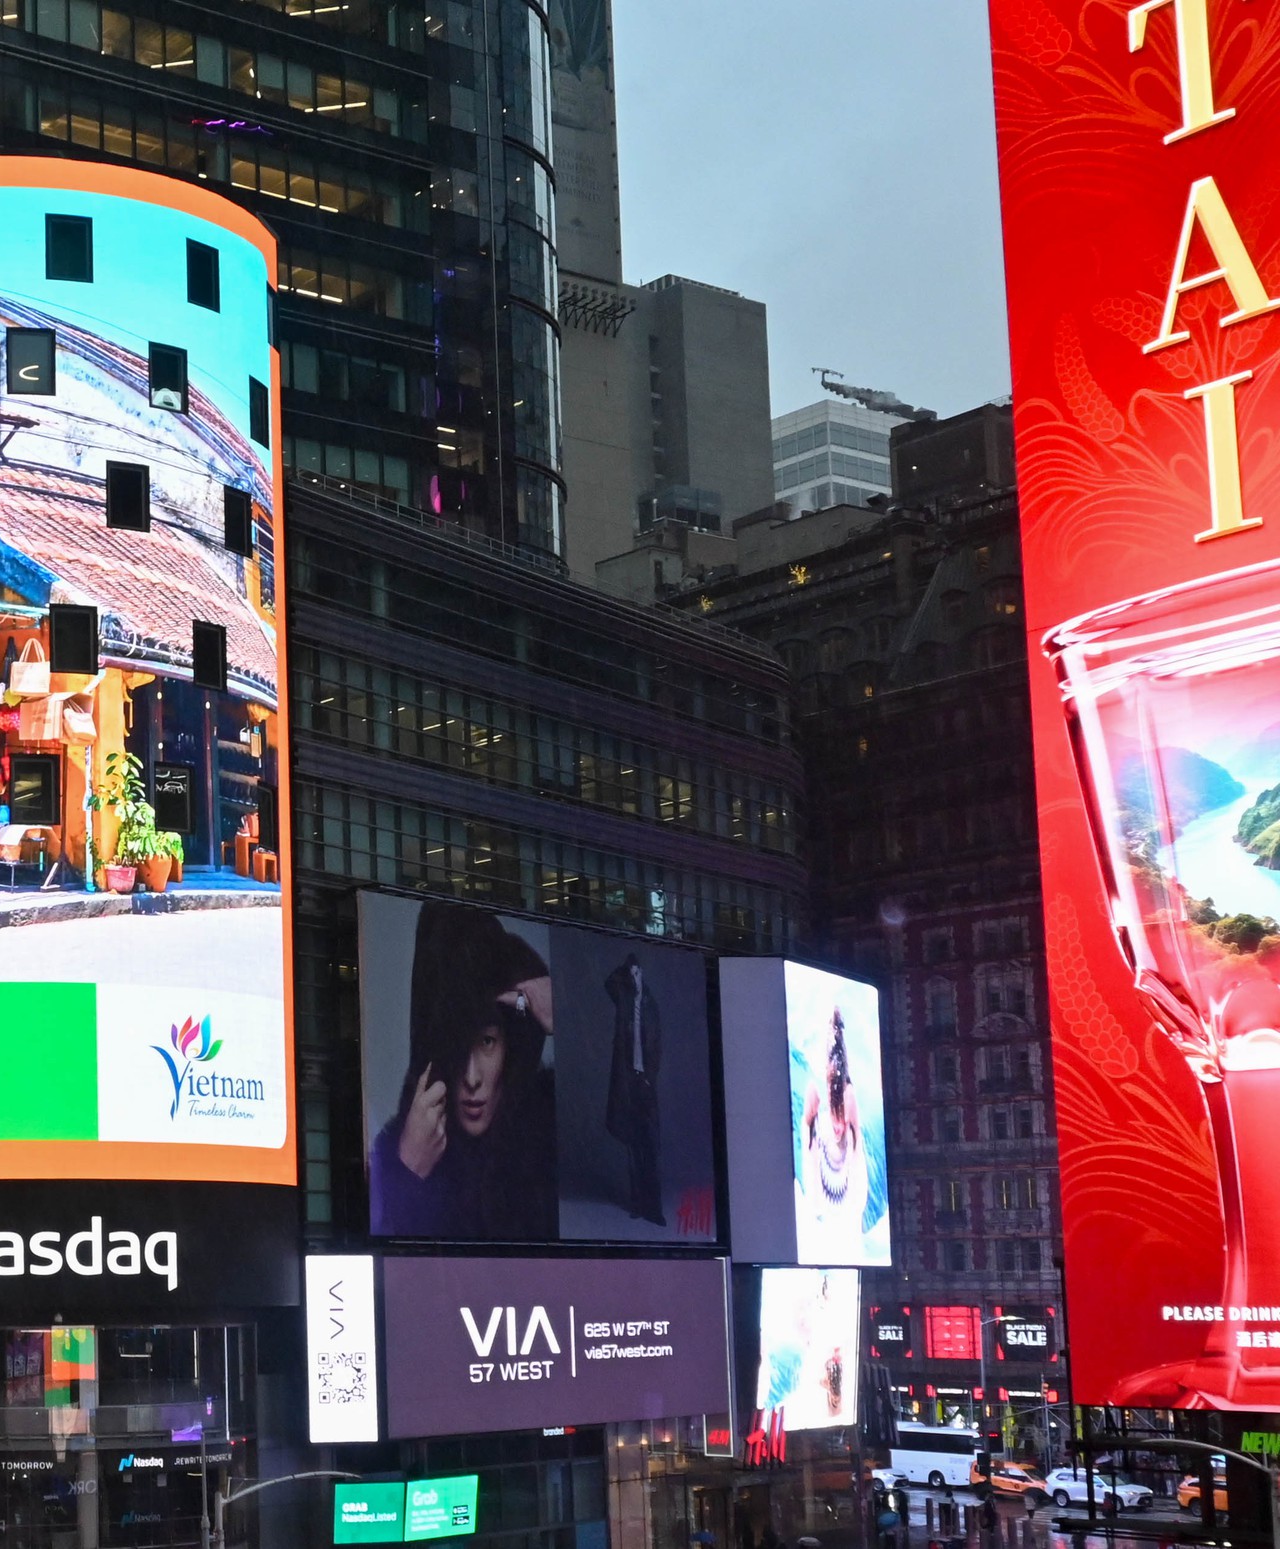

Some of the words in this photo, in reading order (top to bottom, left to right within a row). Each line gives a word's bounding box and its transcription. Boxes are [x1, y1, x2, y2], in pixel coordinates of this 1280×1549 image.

[149, 1045, 265, 1121] Vietnam
[188, 1099, 226, 1117] Timeless
[1162, 1306, 1224, 1321] PLEASE
[1228, 1306, 1280, 1321] DRINK
[584, 1323, 611, 1338] 625
[612, 1323, 625, 1336] W
[653, 1321, 670, 1335] ST
[877, 1330, 904, 1341] SALE
[1006, 1331, 1047, 1346] SALE
[584, 1344, 673, 1360] via57west.com
[469, 1364, 494, 1383] 57
[500, 1361, 554, 1381] WEST
[1, 1462, 54, 1470] TOMORROW
[133, 1457, 164, 1469] Nasdaq
